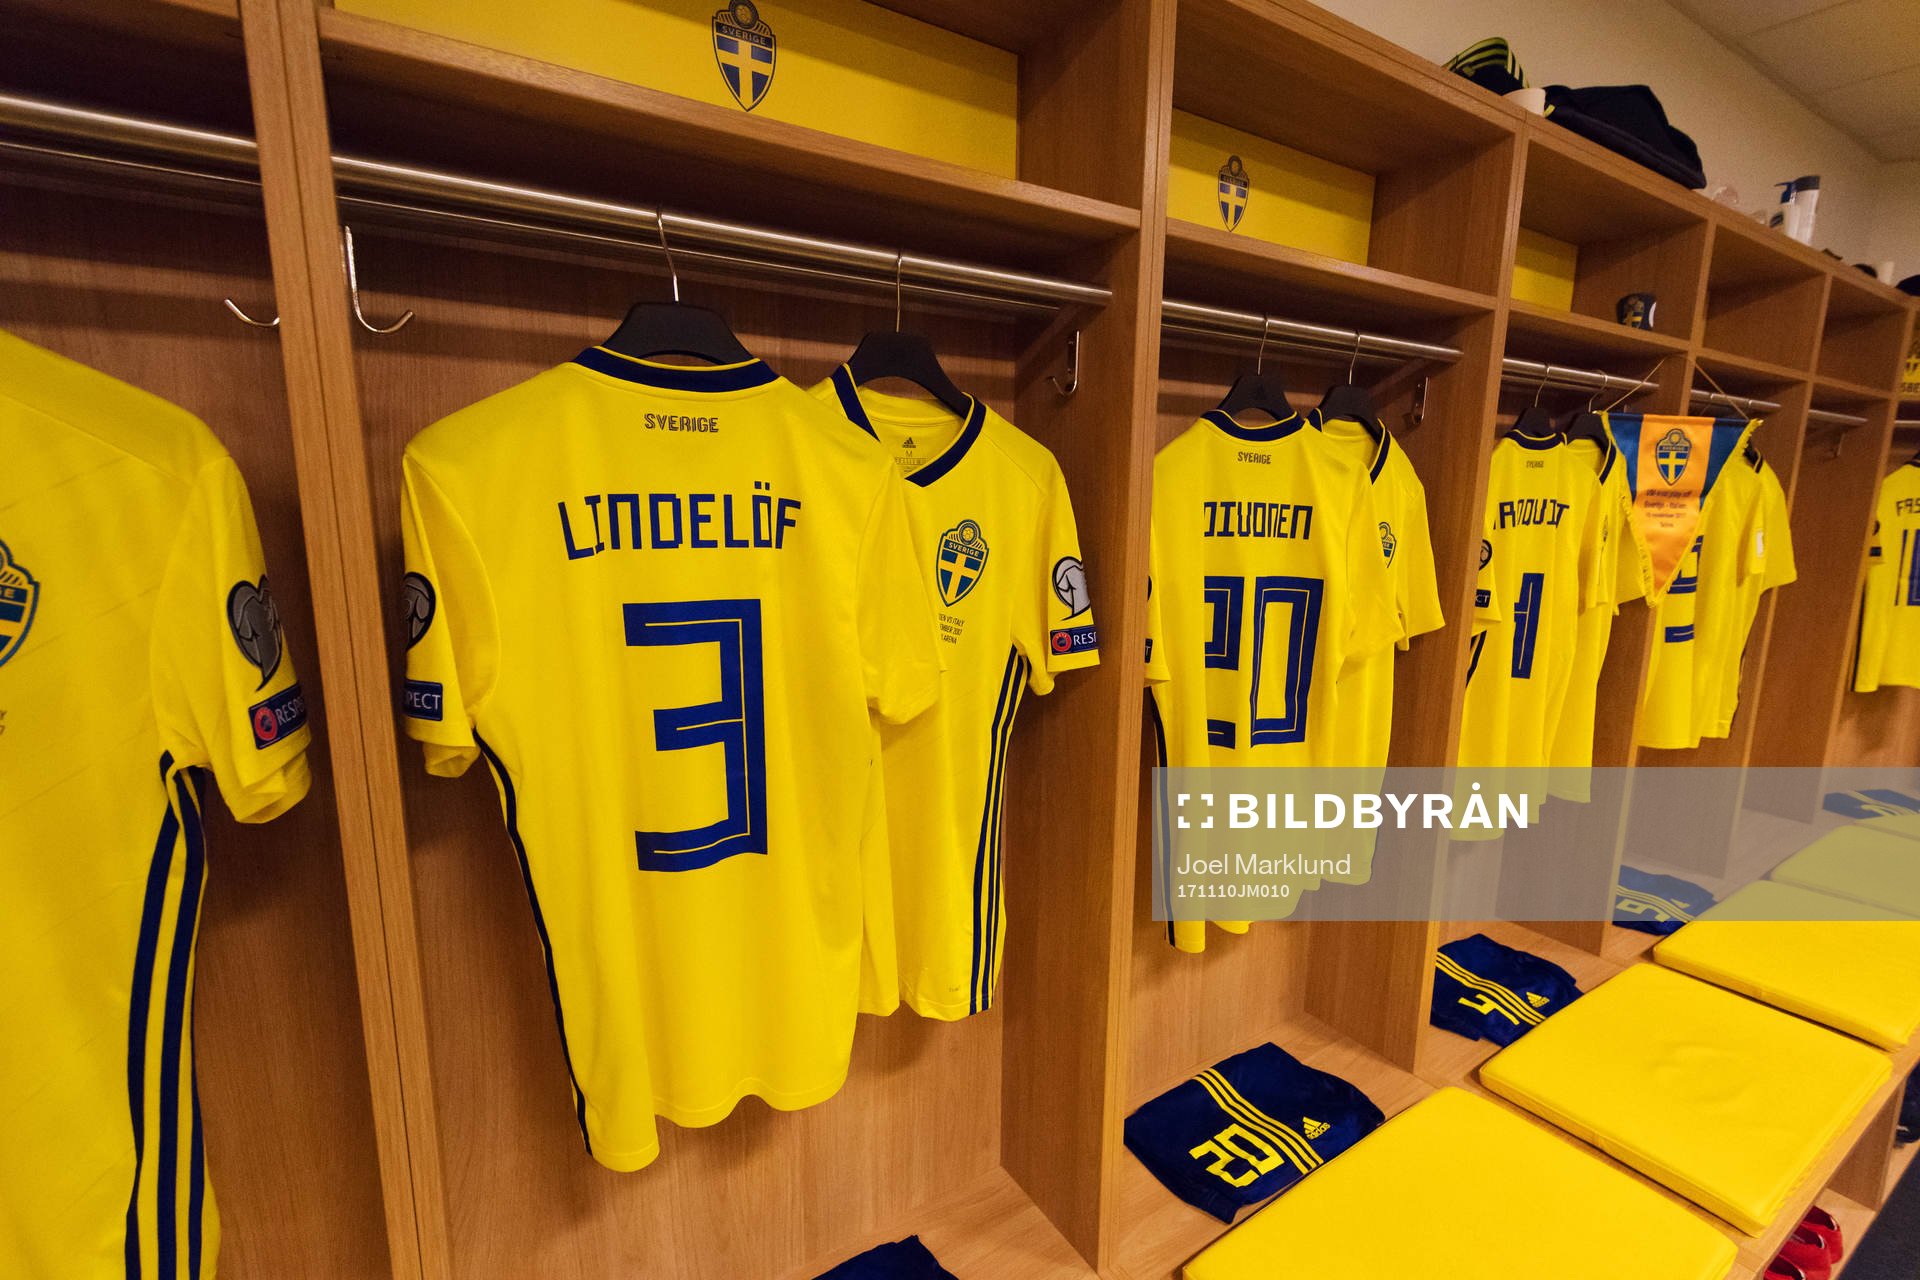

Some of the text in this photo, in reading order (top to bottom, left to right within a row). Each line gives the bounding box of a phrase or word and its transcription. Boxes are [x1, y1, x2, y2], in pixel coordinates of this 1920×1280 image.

[721, 26, 766, 45] SVERIGE
[644, 413, 719, 433] SVERIGE
[1238, 452, 1272, 465] SVERIGE
[558, 481, 801, 561] LINDELÖF
[948, 541, 980, 558] SVERIGE
[622, 598, 768, 873] 3
[1458, 993, 1520, 1026] 4
[1188, 1123, 1285, 1188] 20
